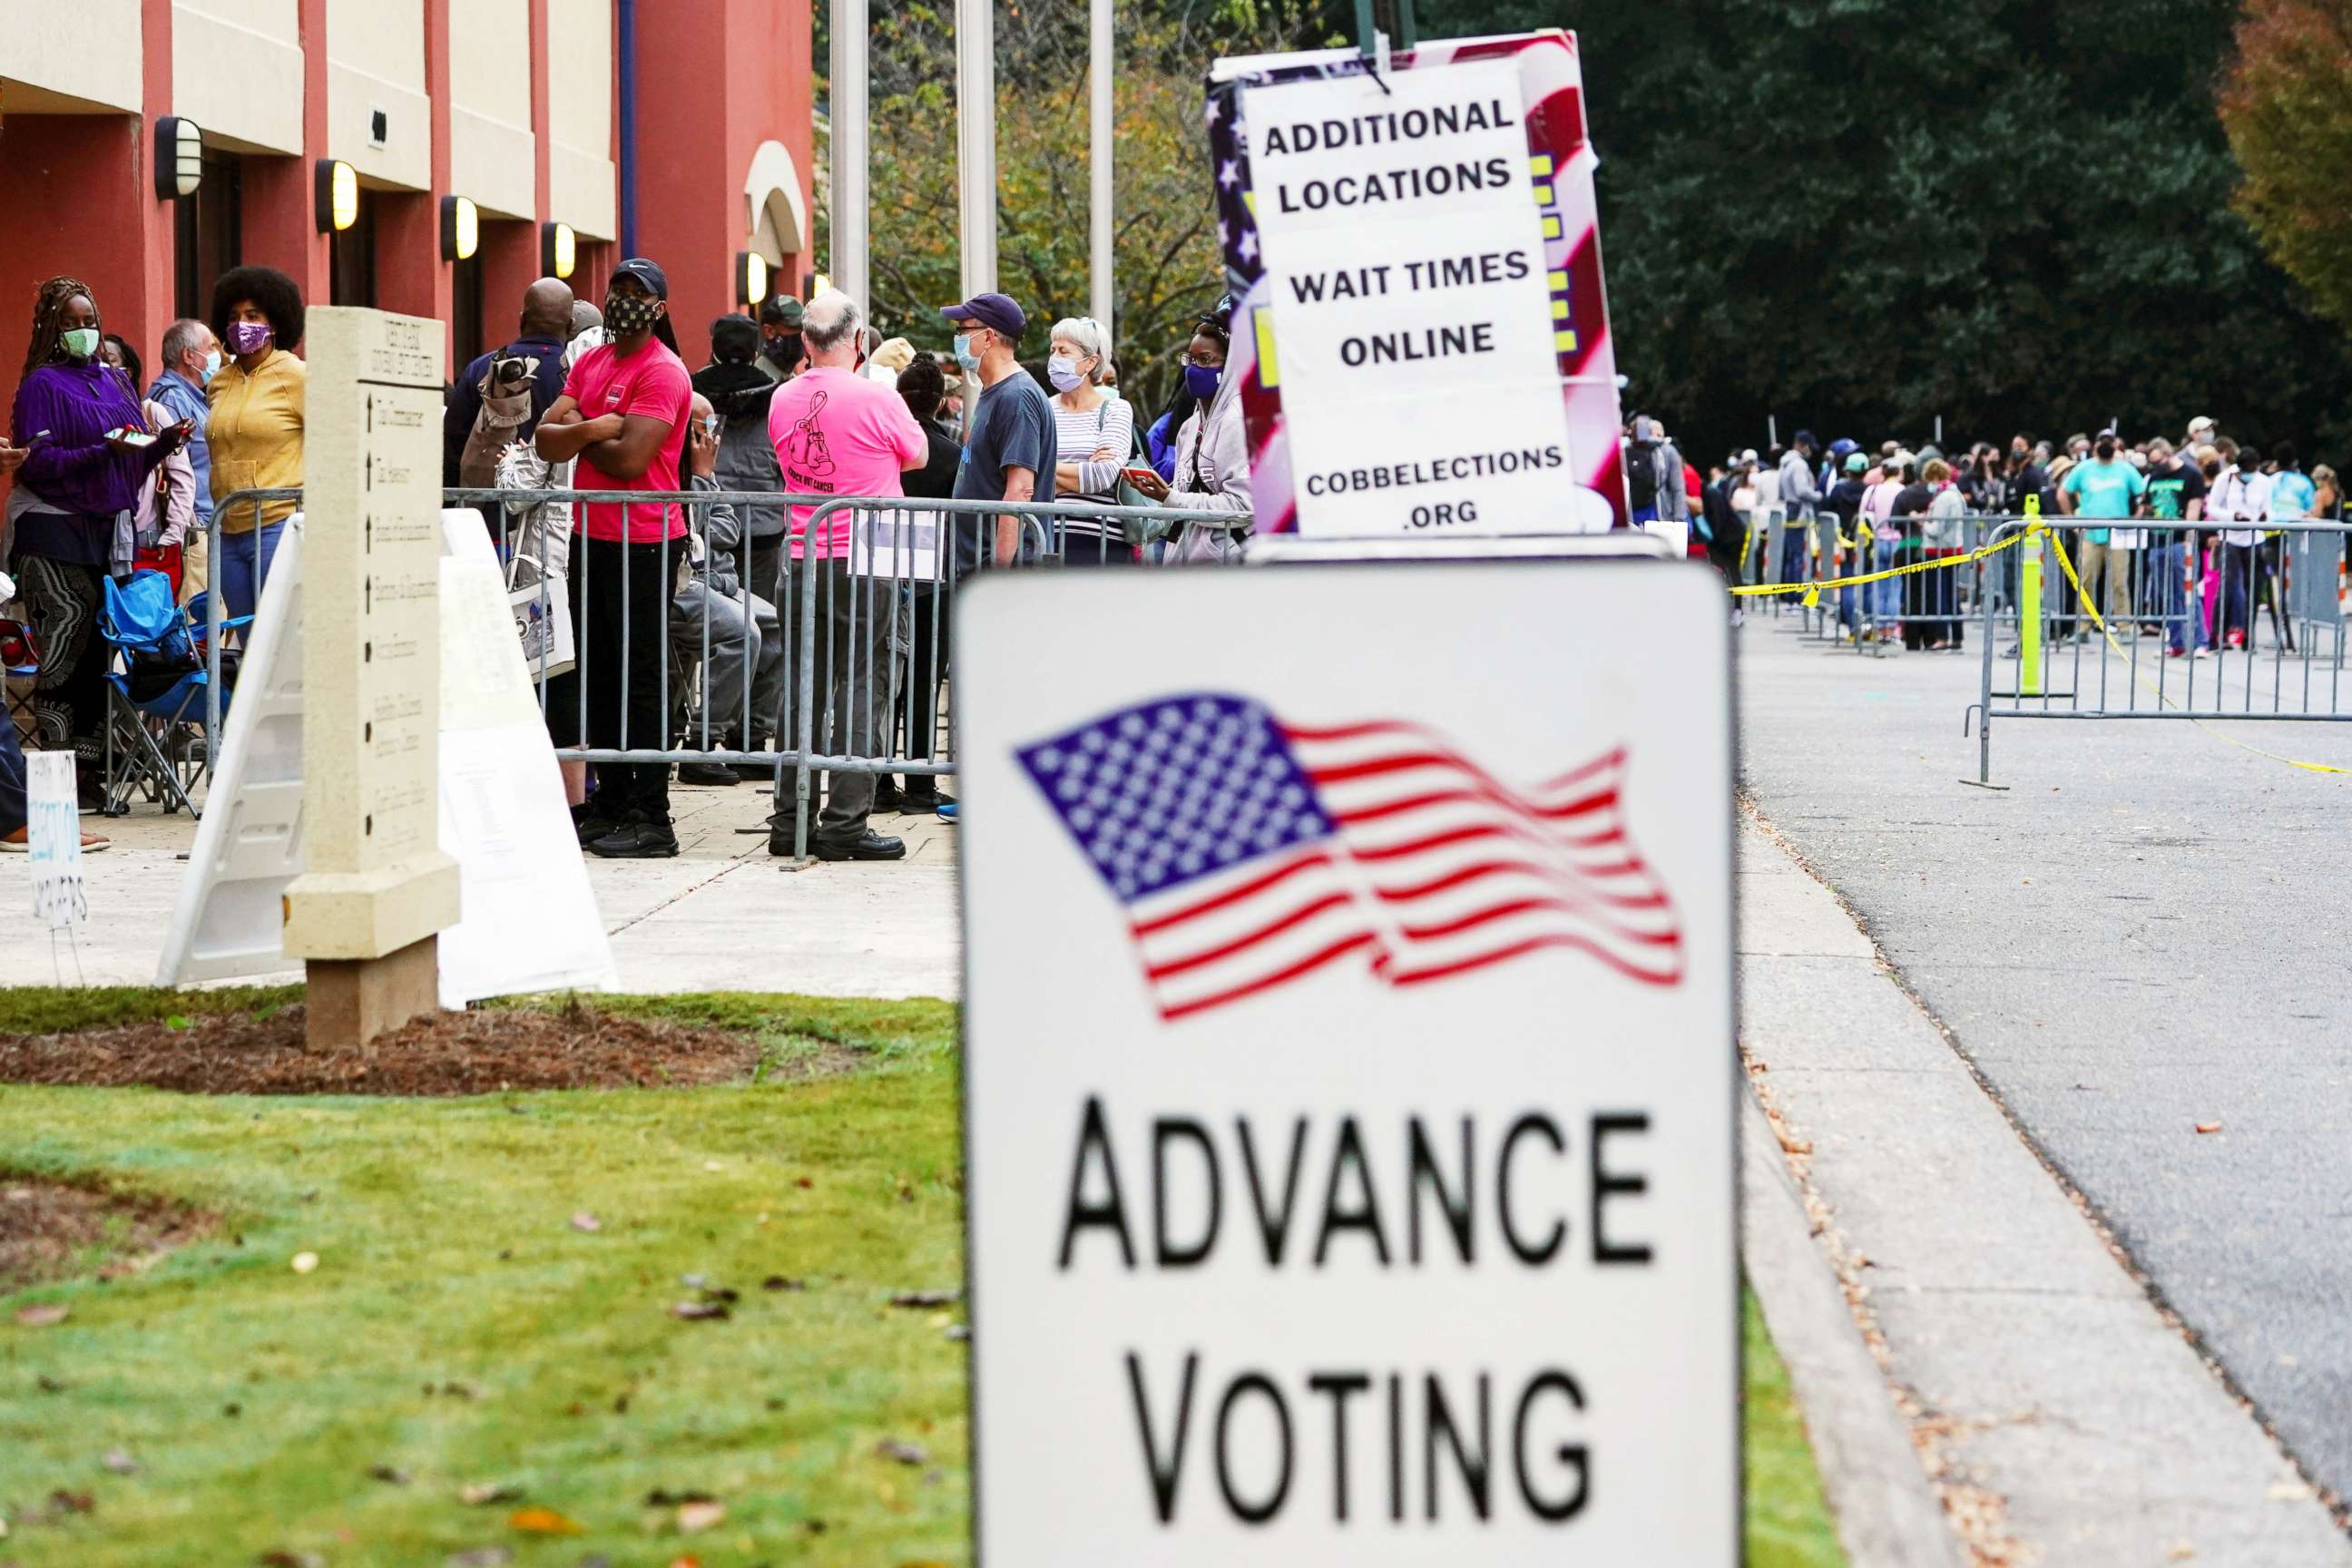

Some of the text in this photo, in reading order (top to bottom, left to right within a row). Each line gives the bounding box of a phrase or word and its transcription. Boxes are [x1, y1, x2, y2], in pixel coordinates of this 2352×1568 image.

[1264, 99, 1514, 157] ADDITIONAL
[1279, 158, 1511, 213] LOCATIONS
[1289, 250, 1529, 304] WAIT TIMES
[1340, 322, 1494, 367] ONLINE
[1307, 446, 1563, 496] COBBELECTIONS
[1403, 501, 1476, 529] .ORG
[1056, 1093, 1655, 1271] ADVANCE
[1124, 1351, 1592, 1528] VOTING
